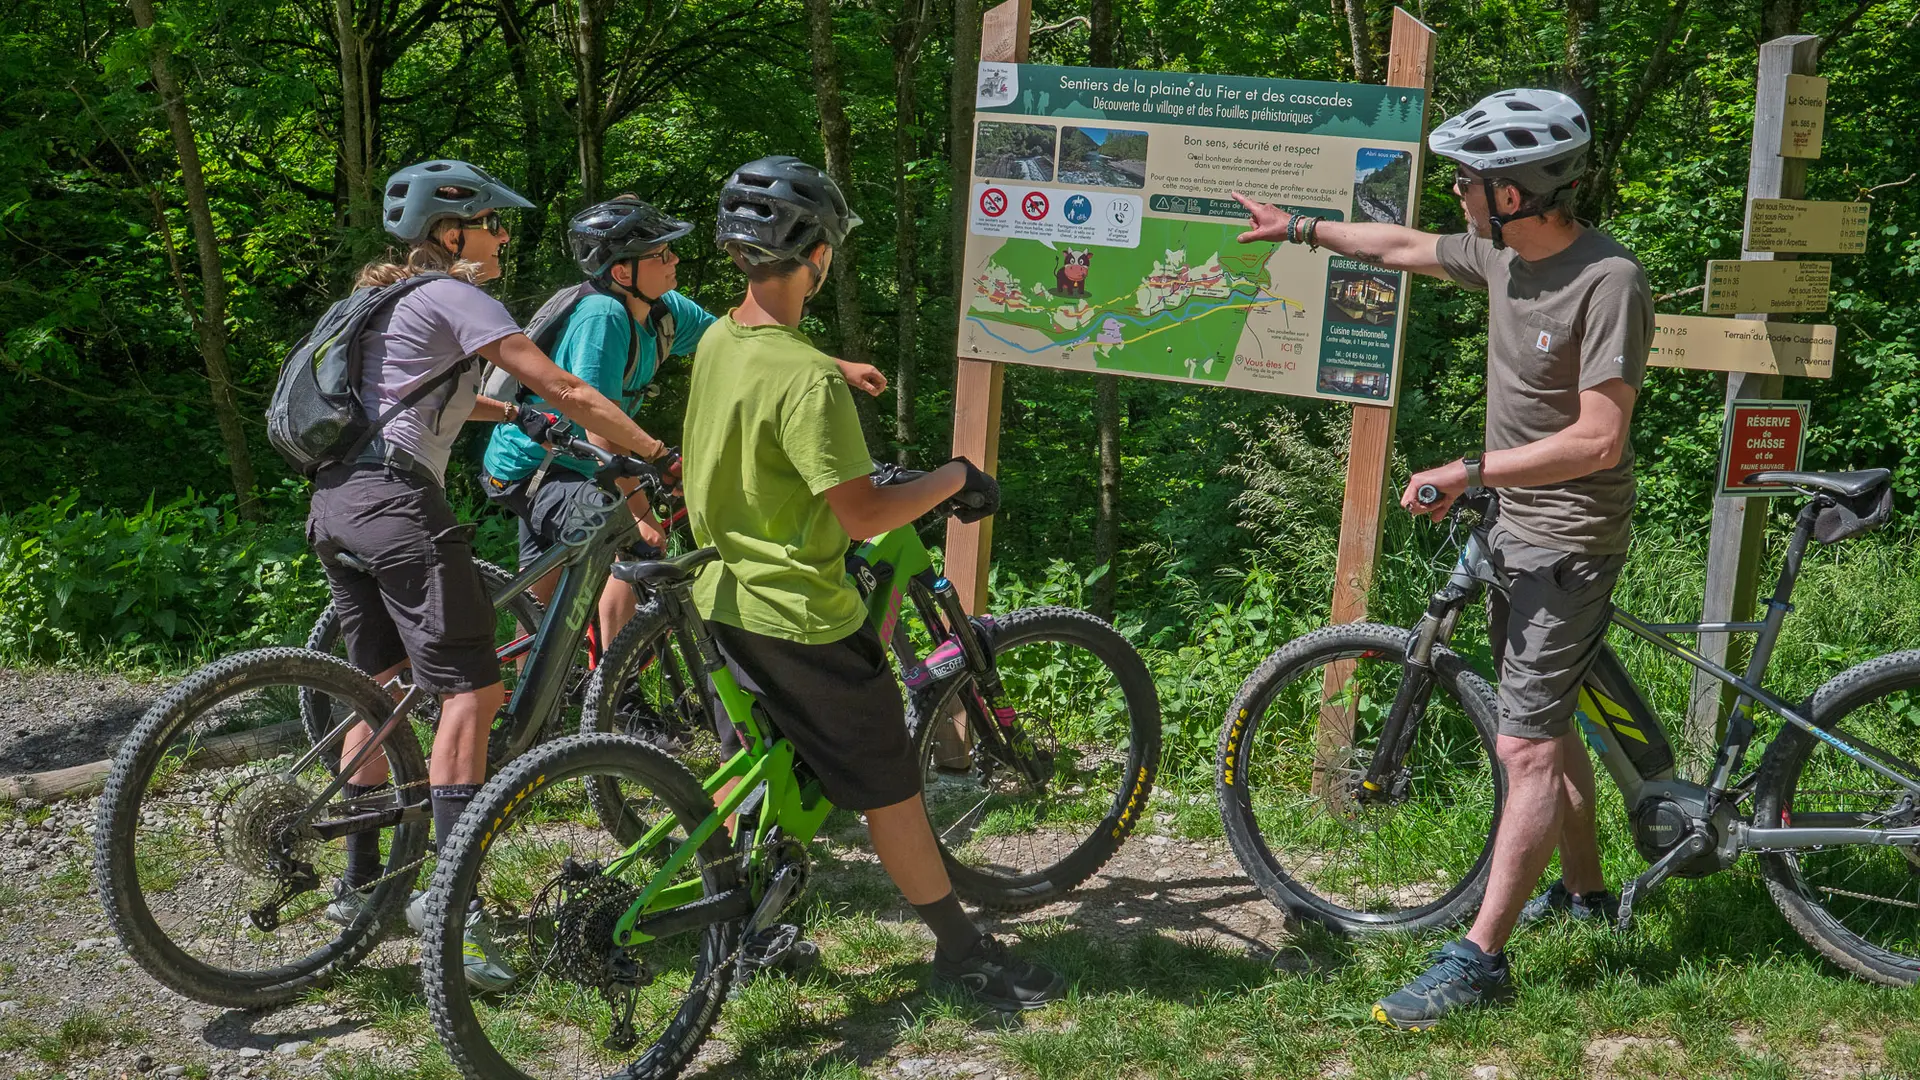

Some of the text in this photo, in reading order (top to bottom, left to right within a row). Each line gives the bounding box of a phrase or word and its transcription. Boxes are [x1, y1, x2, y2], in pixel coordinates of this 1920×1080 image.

[1060, 75, 1353, 107] Sentiers de la plaine du Fier et des cascades
[1788, 95, 1823, 107] La Scierie
[1093, 96, 1314, 126] Découverte du village et des Fouilles préhistoriques
[1184, 135, 1320, 156] Bon sens, sécurité et respect
[1194, 161, 1210, 169] dans
[1222, 164, 1269, 174] environnement
[1271, 167, 1299, 176] préservé
[1205, 153, 1232, 163] bonheur
[1233, 156, 1242, 164] de
[1244, 158, 1271, 166] marcher
[1283, 160, 1292, 168] de
[1294, 161, 1313, 170] rouler
[1150, 173, 1165, 181] Pour
[1193, 176, 1216, 185] enfants
[1244, 181, 1268, 189] chance
[1280, 184, 1304, 194] profiter
[1338, 188, 1348, 196] de
[1162, 182, 1178, 190] cette
[1179, 185, 1201, 193] magie,
[1203, 187, 1222, 195] soyez
[1257, 190, 1281, 200] citoyen
[1291, 194, 1334, 203] responsable.
[1112, 201, 1129, 212] 112
[1209, 199, 1218, 208] En
[1754, 202, 1765, 210] Abri
[1779, 203, 1795, 211] Roche
[1208, 209, 1253, 218] peut immerge
[1751, 225, 1761, 233] Les
[1761, 225, 1787, 233] Cascades
[1331, 259, 1358, 271] AUBERGE
[1358, 262, 1369, 271] des
[1805, 274, 1829, 282] Cascades
[1787, 287, 1798, 295] Abri
[1811, 286, 1828, 294] Roche
[1326, 335, 1338, 343] Centre
[1330, 325, 1388, 340] Cuisine traditionnelle
[1662, 326, 1668, 335] 0
[1669, 327, 1676, 335] h
[1676, 327, 1688, 336] 25
[1723, 330, 1751, 340] Terrain
[1752, 332, 1764, 341] du
[1793, 335, 1833, 346] Cascades
[1281, 343, 1293, 352] ICI
[1661, 347, 1831, 366] 1 h 50 Provenat
[1245, 357, 1296, 371] Vous êtes ICI
[1746, 414, 1791, 427] RÉSERVE
[1762, 430, 1772, 438] de
[1746, 438, 1785, 449] CHASSE
[1755, 451, 1774, 460] et de
[1740, 463, 1759, 471] FAUNE
[879, 584, 903, 646] RUZ
[607, 639, 645, 708] MAXXIS
[930, 656, 965, 679] Muc-Off
[1224, 708, 1249, 785] MAXXIS
[1112, 766, 1148, 839] MAXXIS
[480, 774, 546, 852] MAXXIS
[1648, 824, 1673, 832] YAMAHA
[331, 919, 381, 970] MAXX
